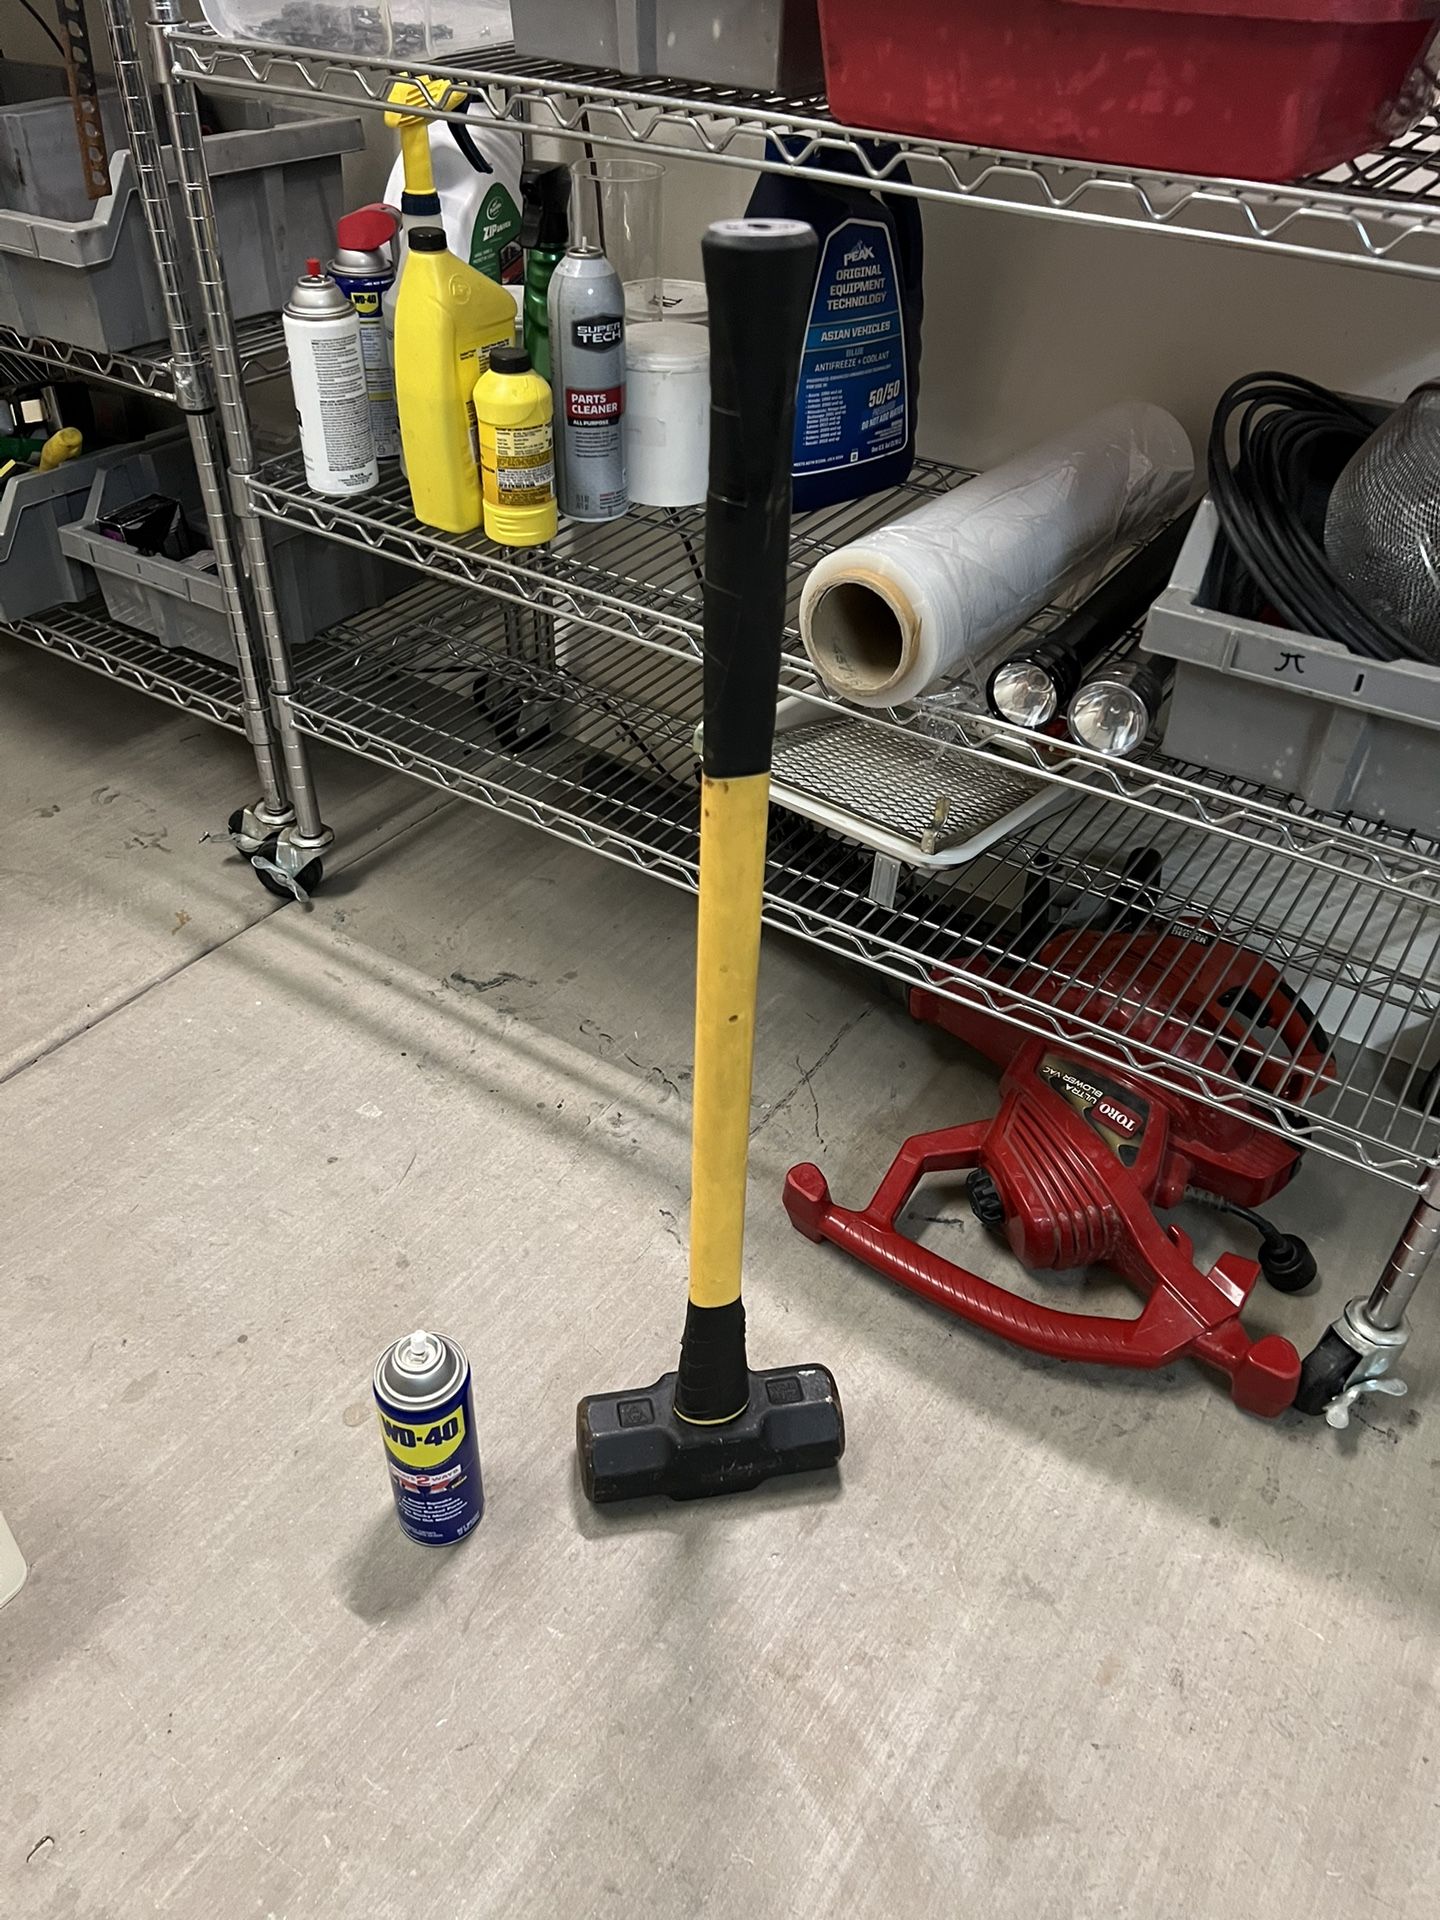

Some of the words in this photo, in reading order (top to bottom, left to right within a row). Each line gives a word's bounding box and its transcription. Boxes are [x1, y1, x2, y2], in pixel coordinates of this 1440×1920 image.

[843, 246, 875, 266] PEAK
[836, 264, 882, 281] ORIGINAL
[829, 278, 886, 297] EQUIPMENT
[826, 292, 887, 311] TECHNOLOGY
[577, 322, 620, 334] SUPER
[577, 330, 621, 343] TECH
[821, 329, 851, 342] ASIAN
[852, 321, 891, 338] VEHICLES
[815, 358, 857, 373] ANTIFREEZE
[571, 393, 607, 405] PARTS
[869, 379, 901, 408] 50/50
[571, 403, 618, 415] CLEANER
[1170, 928, 1207, 945] DECER
[1042, 1066, 1061, 1079] VAC
[1062, 1073, 1104, 1098] BLOWER
[1065, 1083, 1098, 1105] ULTRA
[1099, 1103, 1136, 1132] TORO
[380, 1414, 459, 1448] WD-40
